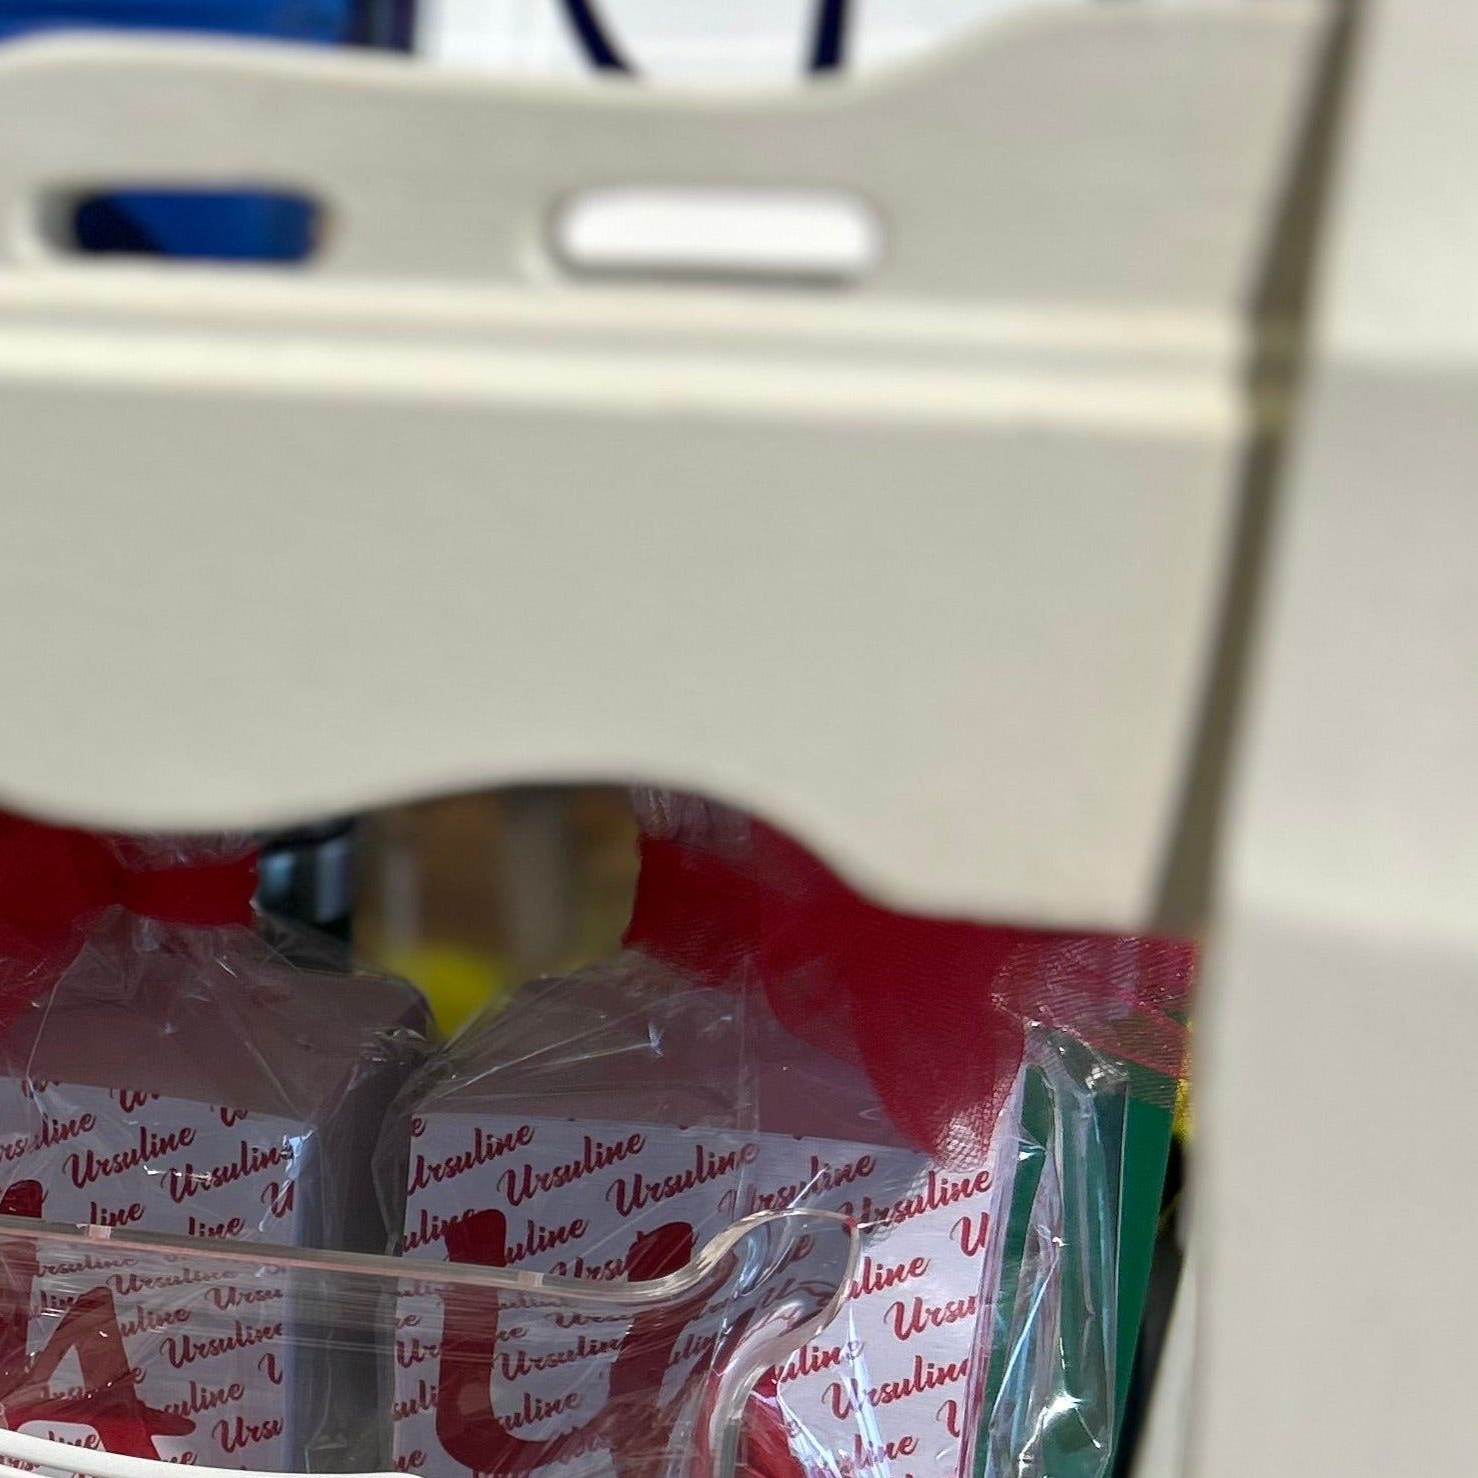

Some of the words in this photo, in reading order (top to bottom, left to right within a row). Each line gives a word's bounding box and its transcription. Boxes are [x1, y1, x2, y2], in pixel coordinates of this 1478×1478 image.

[62, 1126, 196, 1189] Ursuline
[497, 1132, 646, 1207] Ursuline
[606, 1142, 759, 1217] Ursuline
[506, 1218, 590, 1266] uline
